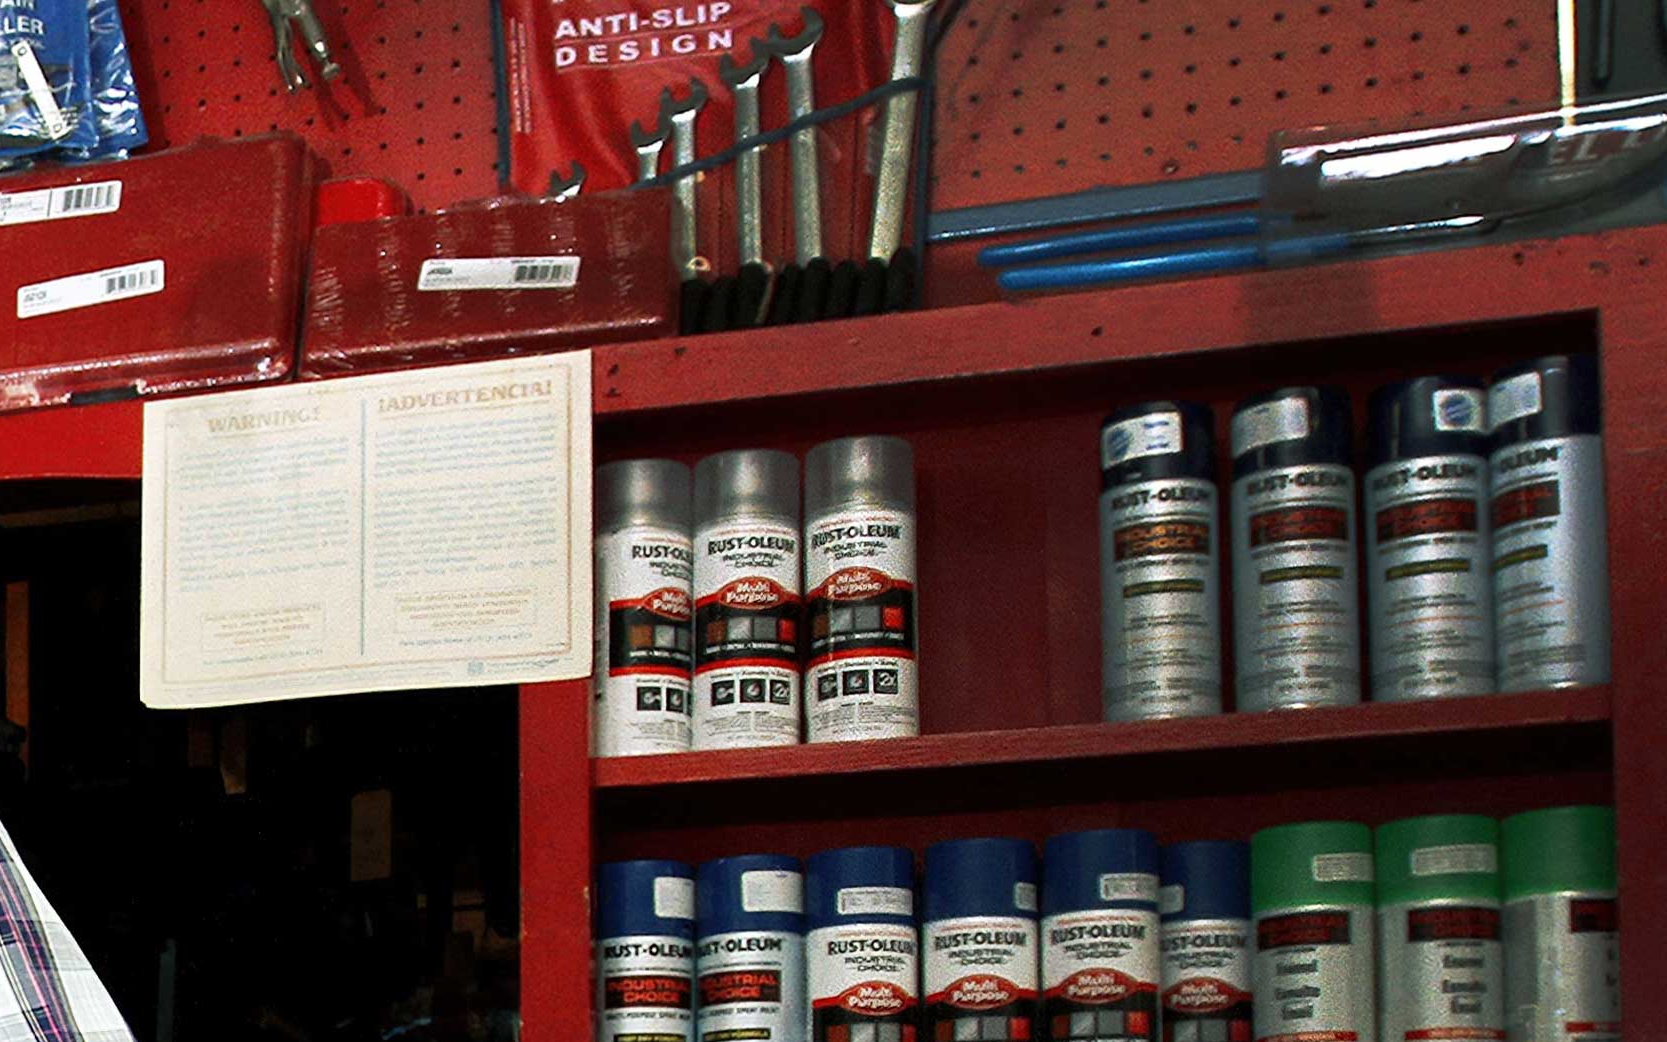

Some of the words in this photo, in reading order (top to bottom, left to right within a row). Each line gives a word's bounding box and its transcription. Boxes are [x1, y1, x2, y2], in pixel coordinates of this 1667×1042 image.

[554, 2, 732, 40] ANTI-SLIP
[207, 404, 321, 433] WARNING!
[708, 534, 796, 556] RUST-OLEUM
[811, 524, 903, 550] RUST-OLEUM
[632, 544, 691, 562] RUST-OL
[934, 931, 1027, 948] RUST-OLEUM
[1051, 924, 1147, 944] RUST-OLEUM
[603, 943, 692, 959] RUST-OLEUM
